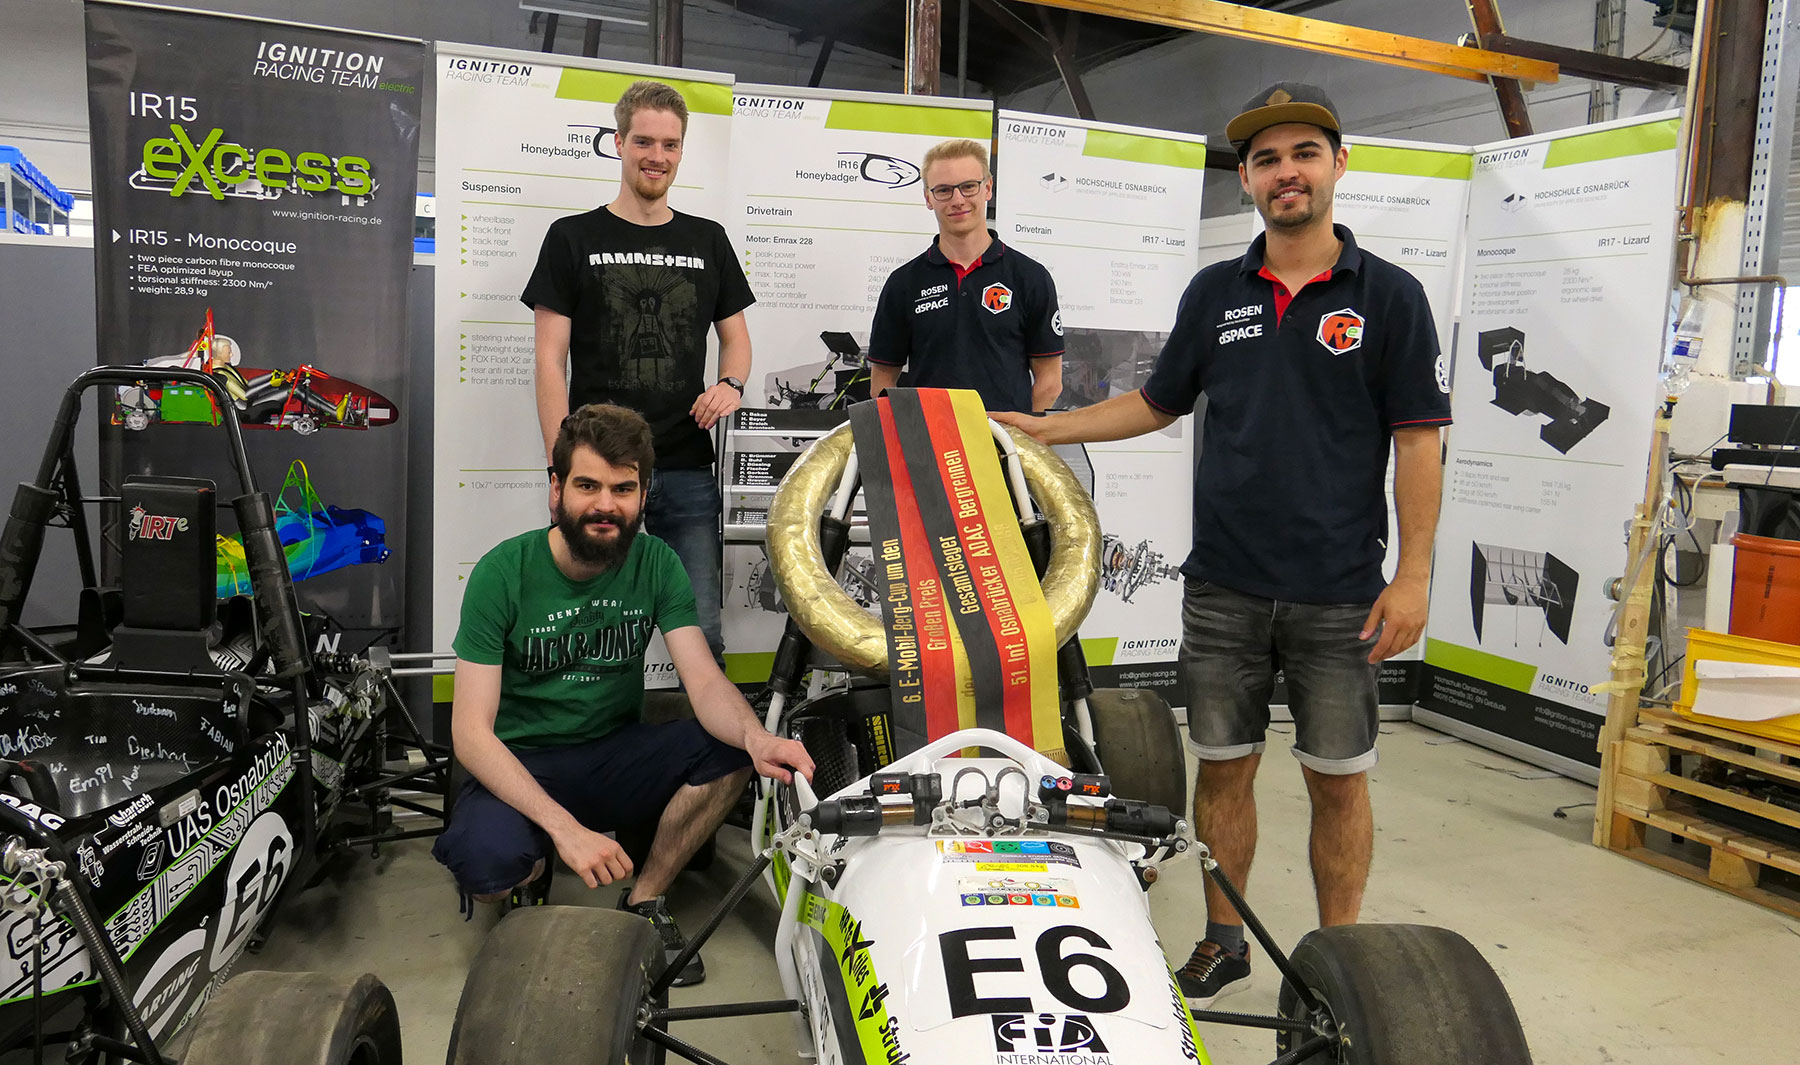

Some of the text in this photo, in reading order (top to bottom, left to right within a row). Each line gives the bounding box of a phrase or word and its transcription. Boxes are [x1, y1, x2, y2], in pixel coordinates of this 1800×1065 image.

[256, 42, 384, 73] IGNITION
[449, 59, 532, 76] IGNITION
[253, 61, 415, 94] RACING TEAM electric
[446, 70, 493, 84] RACING
[496, 75, 529, 87] TEAM
[129, 91, 198, 121] IR15
[732, 96, 805, 110] IGNITION
[772, 109, 802, 120] TEAM
[1007, 123, 1066, 138] IGNITION
[567, 133, 591, 144] IR16
[1005, 134, 1038, 144] RACING
[1040, 137, 1065, 147] TEAM
[521, 143, 591, 158] Honeybadger
[1478, 148, 1529, 165] IGNITION
[143, 124, 372, 200] eXcess
[837, 160, 859, 170] IR16
[795, 170, 859, 184] Honeybadger
[462, 181, 522, 195] Suspension
[1076, 177, 1167, 194] HOCHSCHULE OSNABRÜCK
[1534, 180, 1630, 200] HOCHSCHULE OSNABRÜCK
[1335, 193, 1430, 206] HOCHSCHULE OSNABRÜCK
[272, 208, 382, 226] www.ignition-racing.de
[746, 206, 793, 217] Drivetrain
[472, 215, 515, 224] wheelbase
[472, 226, 511, 235] track front
[1015, 224, 1186, 247] Drivetrain IR17 Lizard
[129, 229, 297, 255] IR15 Monocoque
[472, 237, 492, 245] track
[746, 235, 813, 245] Motor: Emrax 228
[1477, 235, 1650, 257] Monocoque IR17 Lizard
[472, 249, 517, 258] suspension
[755, 251, 773, 259] peak
[869, 255, 882, 263] 100
[1401, 247, 1447, 258] IR17 Lizard
[137, 254, 295, 271] two piece carbon fibre monocoque
[472, 259, 489, 267] tires
[589, 252, 705, 270] RAMMSTEIN
[755, 261, 793, 269] continuous
[137, 264, 234, 277] FEA optimized layup
[774, 271, 796, 280] torque
[137, 275, 178, 284] torsional
[181, 276, 220, 286] stiffness:
[222, 279, 247, 288] 2300
[774, 281, 795, 289] speed
[138, 285, 208, 297] weight: 28,9 kg
[472, 292, 517, 301] suspension
[776, 291, 807, 299] controller
[921, 284, 948, 297] ROSEN
[841, 304, 864, 312] cooling
[914, 297, 949, 314] dSPACE
[1225, 304, 1263, 321] ROSEN
[471, 334, 526, 343] steering wheel
[1219, 324, 1263, 345] dSPACE
[471, 345, 512, 354] lightweight
[471, 355, 489, 363] FOX
[490, 355, 509, 364] Float
[510, 356, 521, 364] X2
[471, 377, 517, 385] front anti roll
[1456, 458, 1493, 467] Aerodynamics
[494, 481, 533, 490] composite
[944, 449, 979, 519] Bergrennen
[963, 523, 992, 558] ADAC
[939, 536, 981, 615] Gesamtsieger
[917, 578, 940, 609] Preis
[980, 565, 1021, 637] Osnabrücker
[881, 538, 922, 703] 6. E-Mobil-Berg-Cup um den
[530, 625, 557, 634] TRADE
[520, 634, 573, 673] JACK
[588, 616, 653, 662] JONES
[1122, 639, 1178, 649] IGNITION
[1005, 638, 1026, 664] Int.
[1120, 647, 1176, 657] RACING TEAM
[1012, 666, 1028, 686] 51.
[1119, 669, 1178, 680] info@ignition-racing.de
[1119, 678, 1178, 688] www.ignition-racing.de
[1541, 674, 1597, 696] IGNITIO
[167, 801, 212, 858] UAS
[216, 731, 290, 815] Osnabrück
[884, 783, 901, 793] FOX
[1083, 784, 1101, 794] FOX
[102, 822, 143, 855] Wasserstrahl
[126, 825, 154, 848] Schneide
[140, 827, 163, 847] Technik
[938, 925, 1131, 1020] E6
[997, 1054, 1114, 1065] INTERNATIONAL
